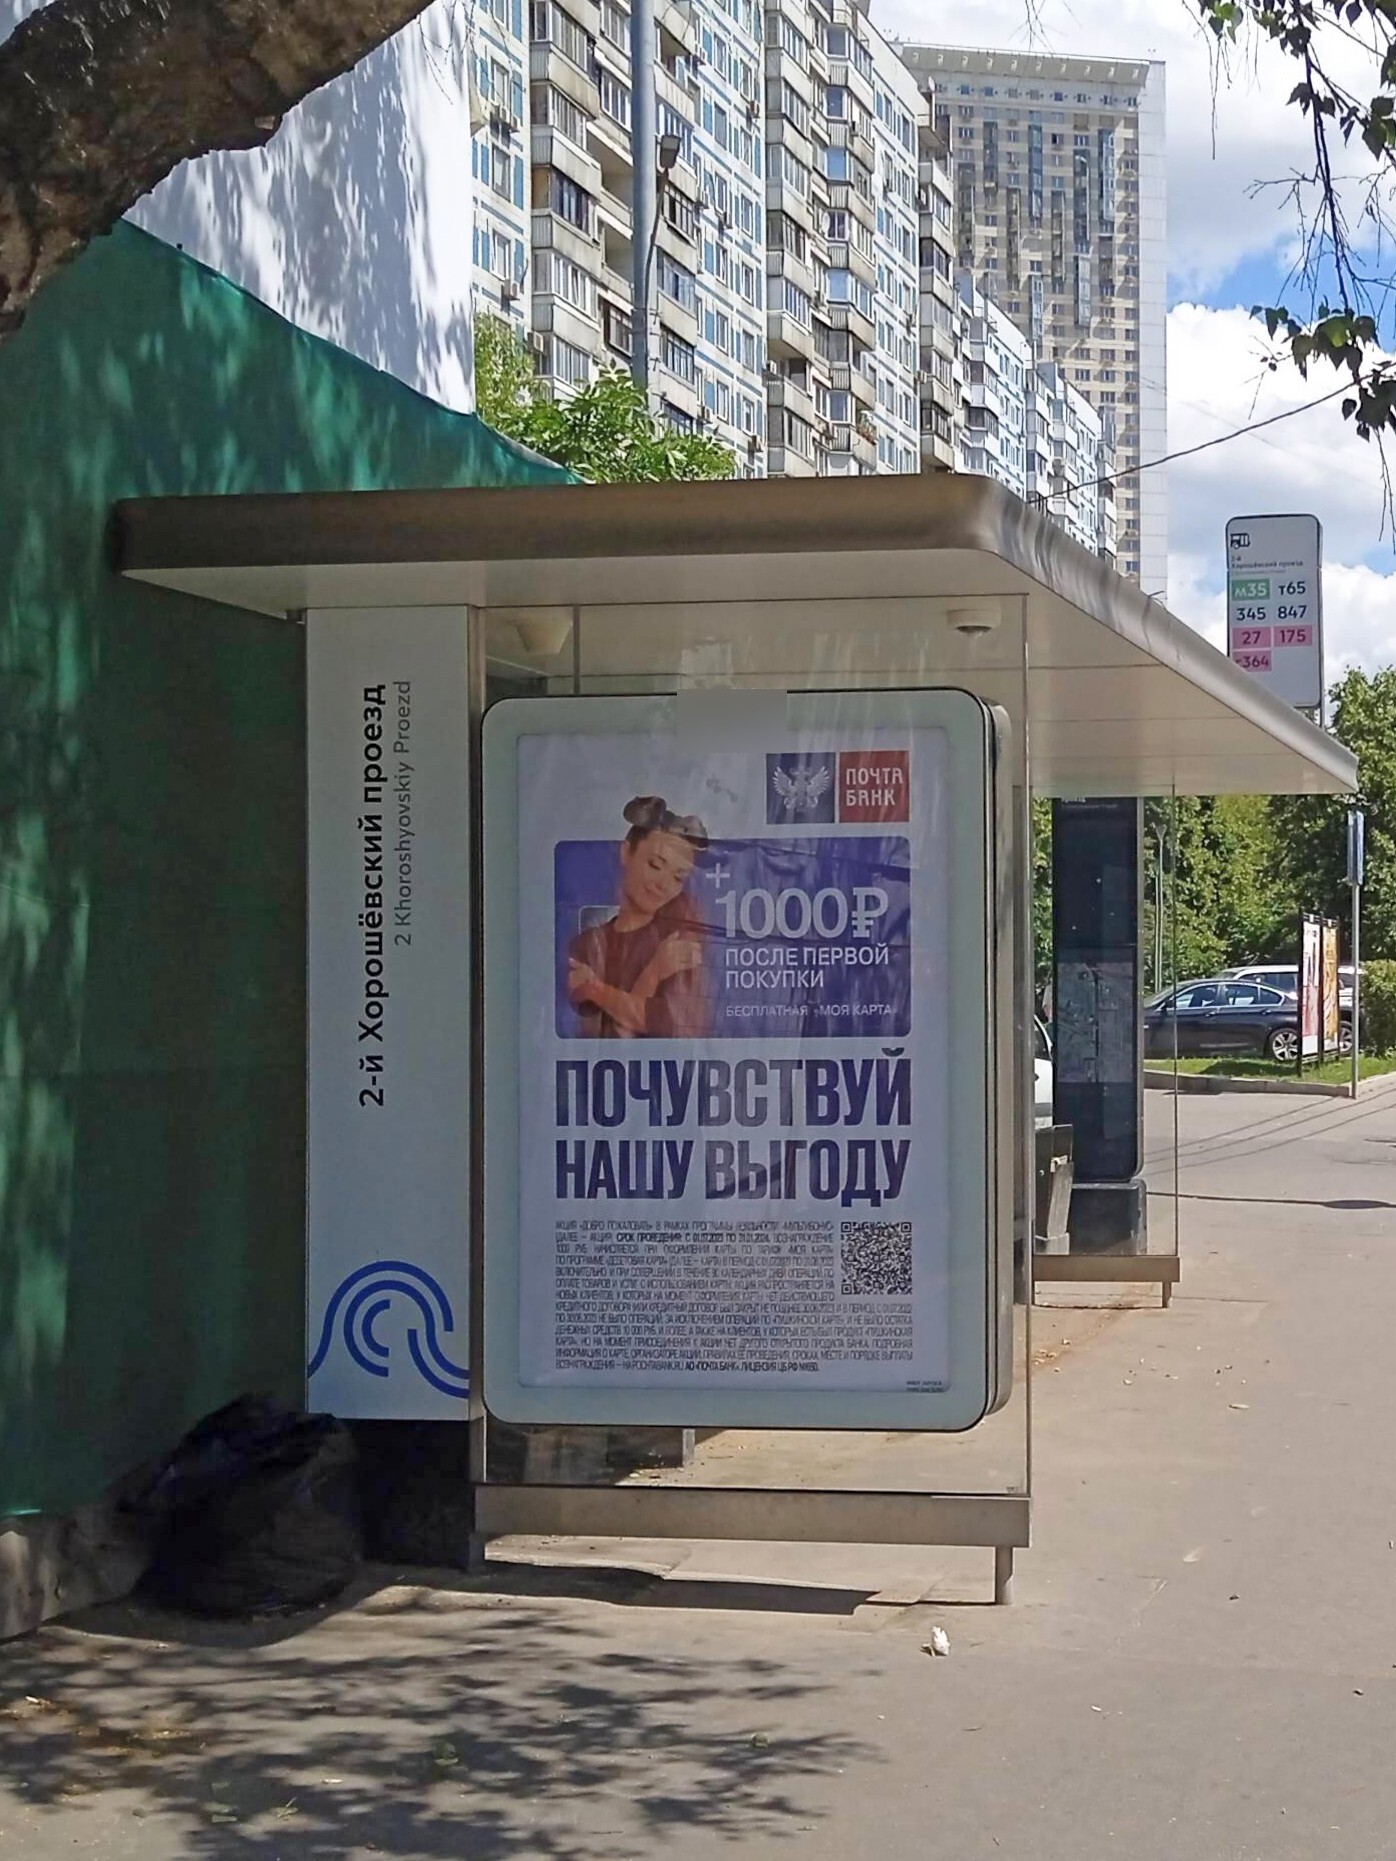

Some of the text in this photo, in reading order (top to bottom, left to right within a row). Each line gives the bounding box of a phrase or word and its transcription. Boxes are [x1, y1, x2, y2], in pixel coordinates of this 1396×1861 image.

[1234, 581, 1306, 598] м35 т65
[1236, 604, 1307, 622] 345 847
[1241, 629, 1306, 645] 27 175
[846, 767, 903, 785] ПОЧТА
[846, 789, 896, 807] БАНК
[393, 681, 415, 945] 2 Khoroshyovskiy Proezd
[357, 684, 389, 1107] 2-й Хорошёвский проезд
[726, 943, 889, 966] ПОСЛЕ ПЕРВОЙ
[726, 970, 824, 989] ПОКУПКИ
[726, 1005, 808, 1017] БЕСПЛАТНАЯ
[555, 1047, 912, 1127] ПОЧУВСТВУЙ
[555, 1140, 912, 1208] НАШУ ВЫГОДУ
